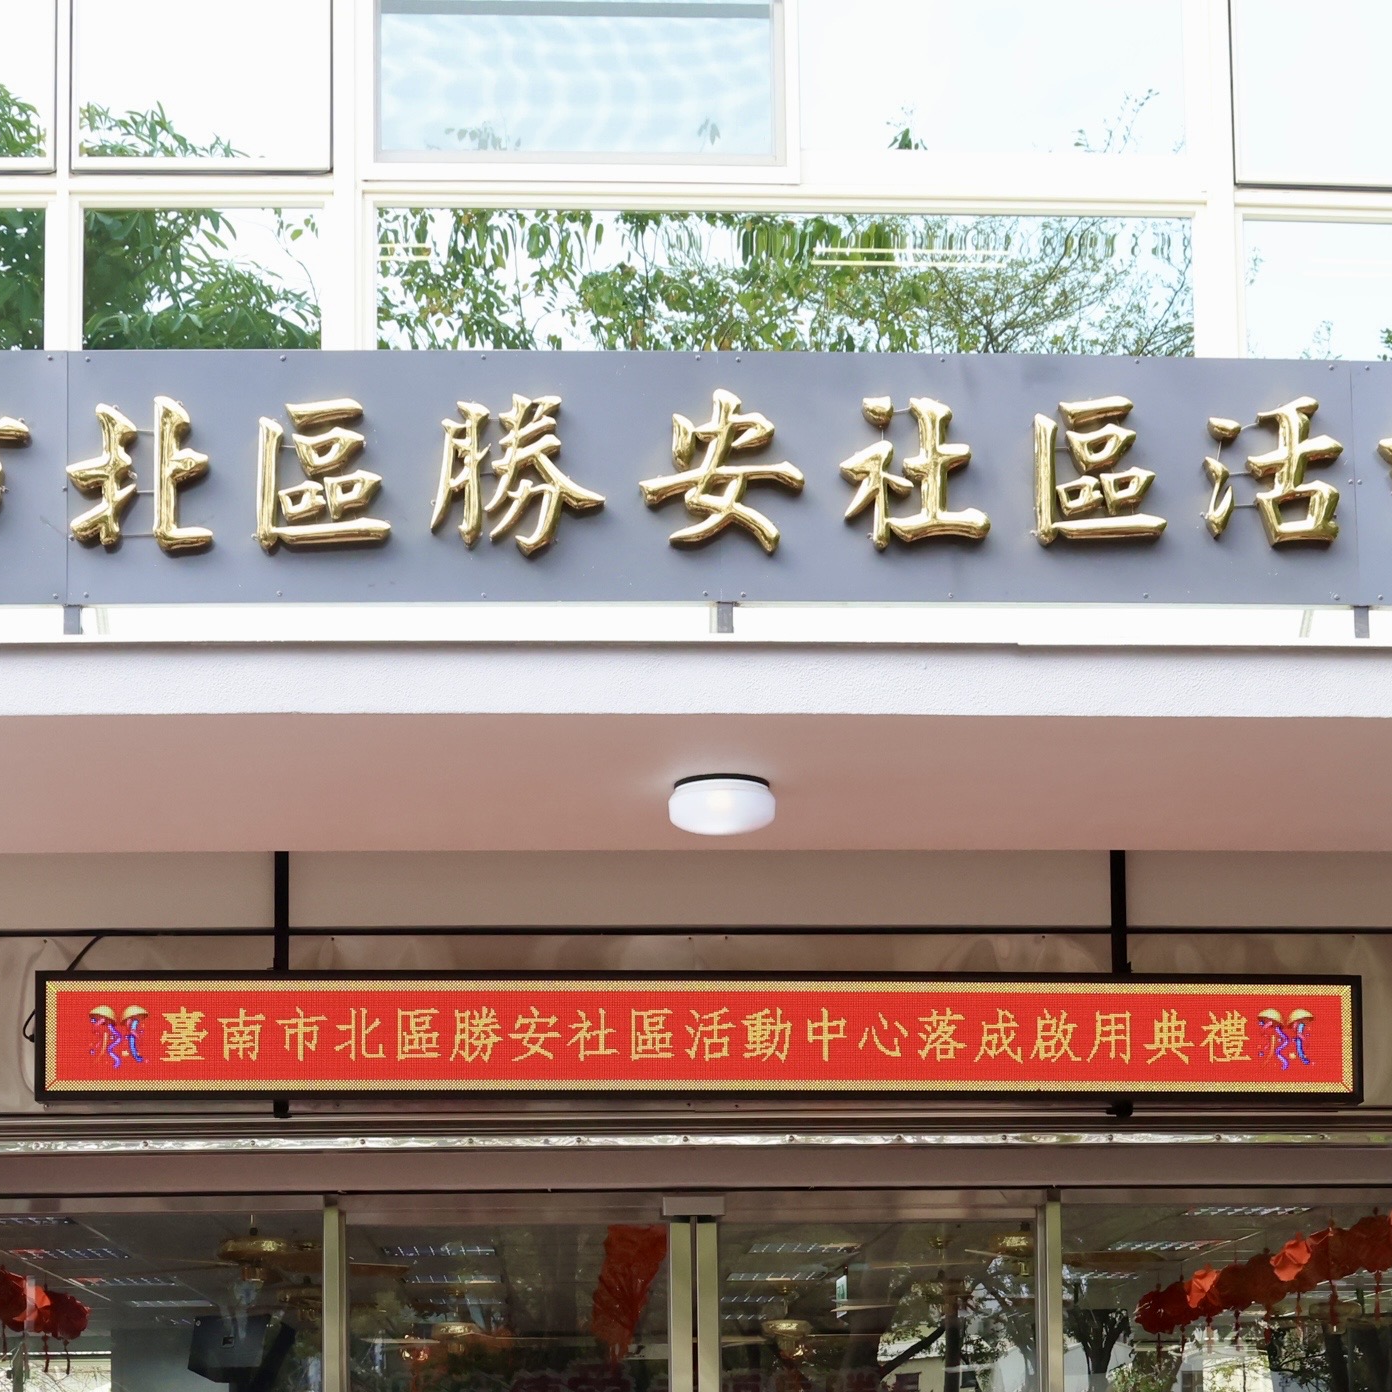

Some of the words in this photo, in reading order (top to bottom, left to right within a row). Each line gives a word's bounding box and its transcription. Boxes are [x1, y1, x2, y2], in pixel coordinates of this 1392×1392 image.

[160, 1005, 1253, 1065] 臺南市北區勝安社區活動中心落成啟用典禮
